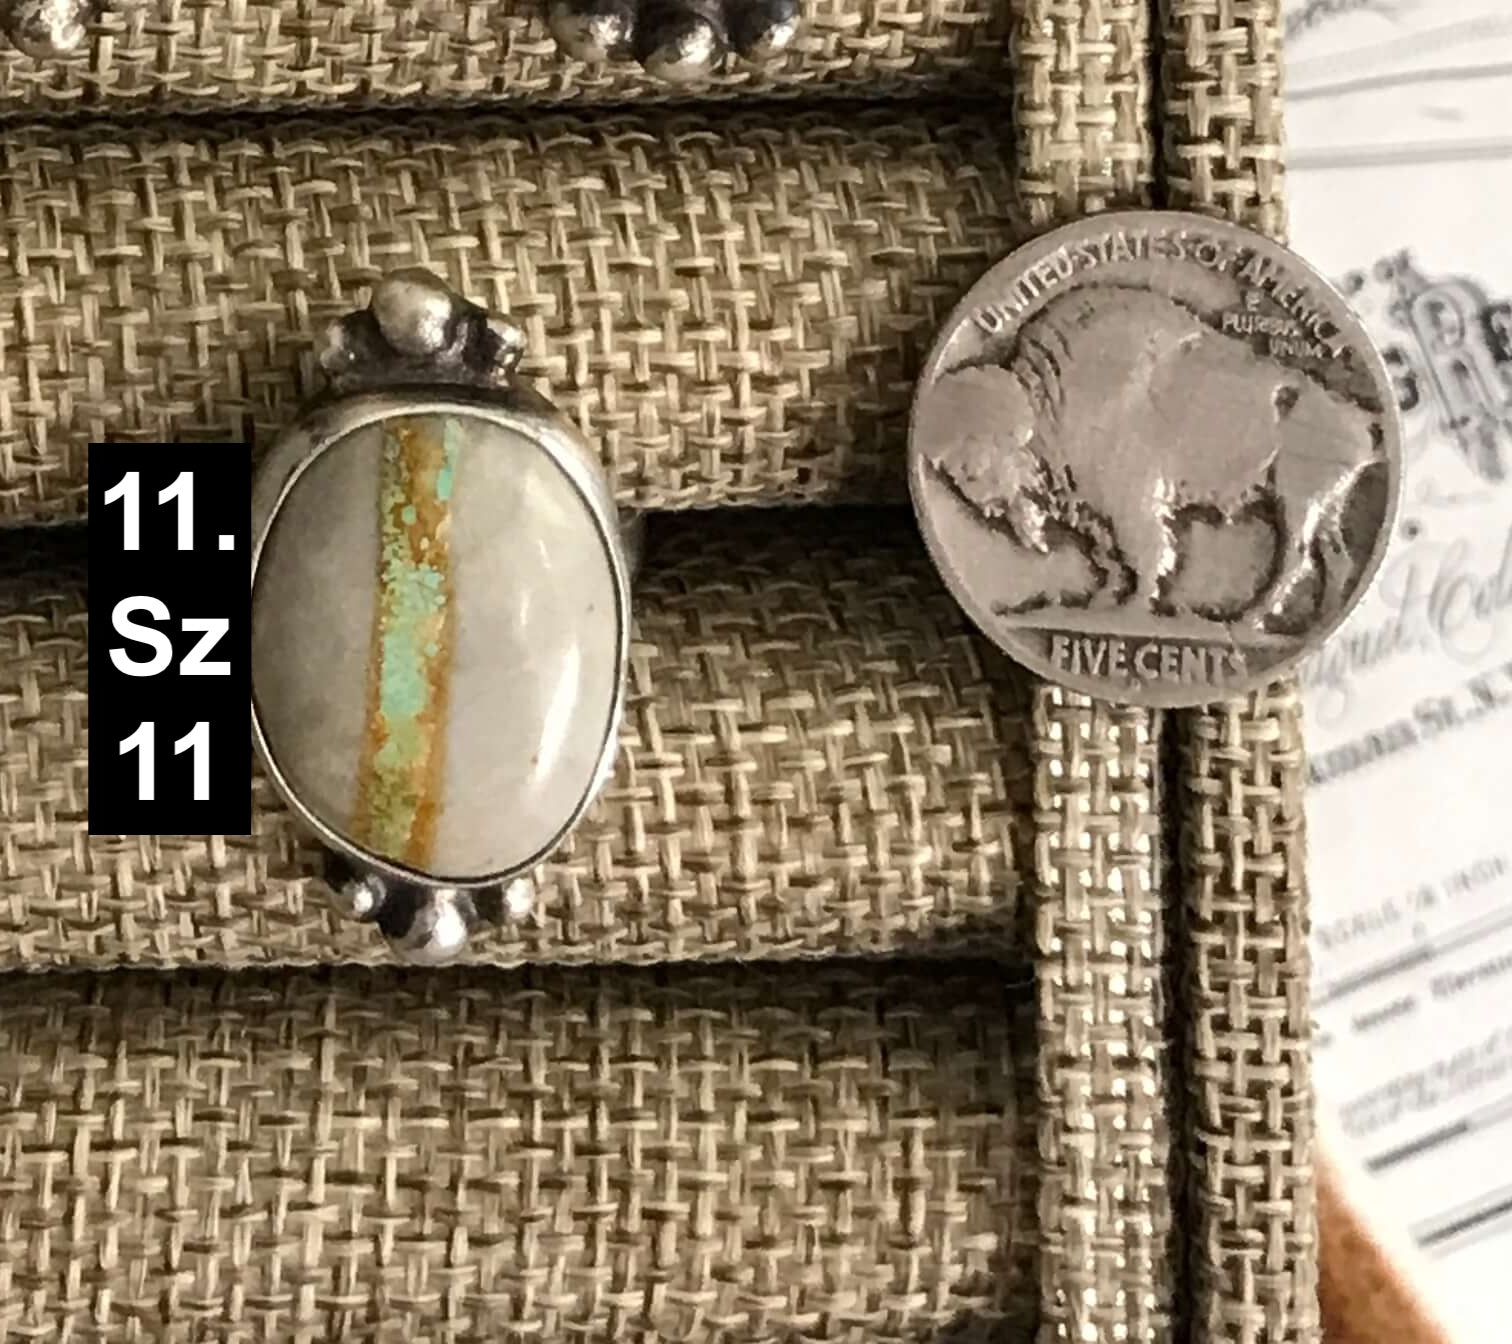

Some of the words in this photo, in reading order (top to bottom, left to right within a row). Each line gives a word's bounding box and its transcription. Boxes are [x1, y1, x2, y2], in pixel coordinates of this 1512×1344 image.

[973, 244, 1074, 335] UNITED
[1050, 633, 1130, 678] FIVE
[1133, 640, 1250, 688] CENTS
